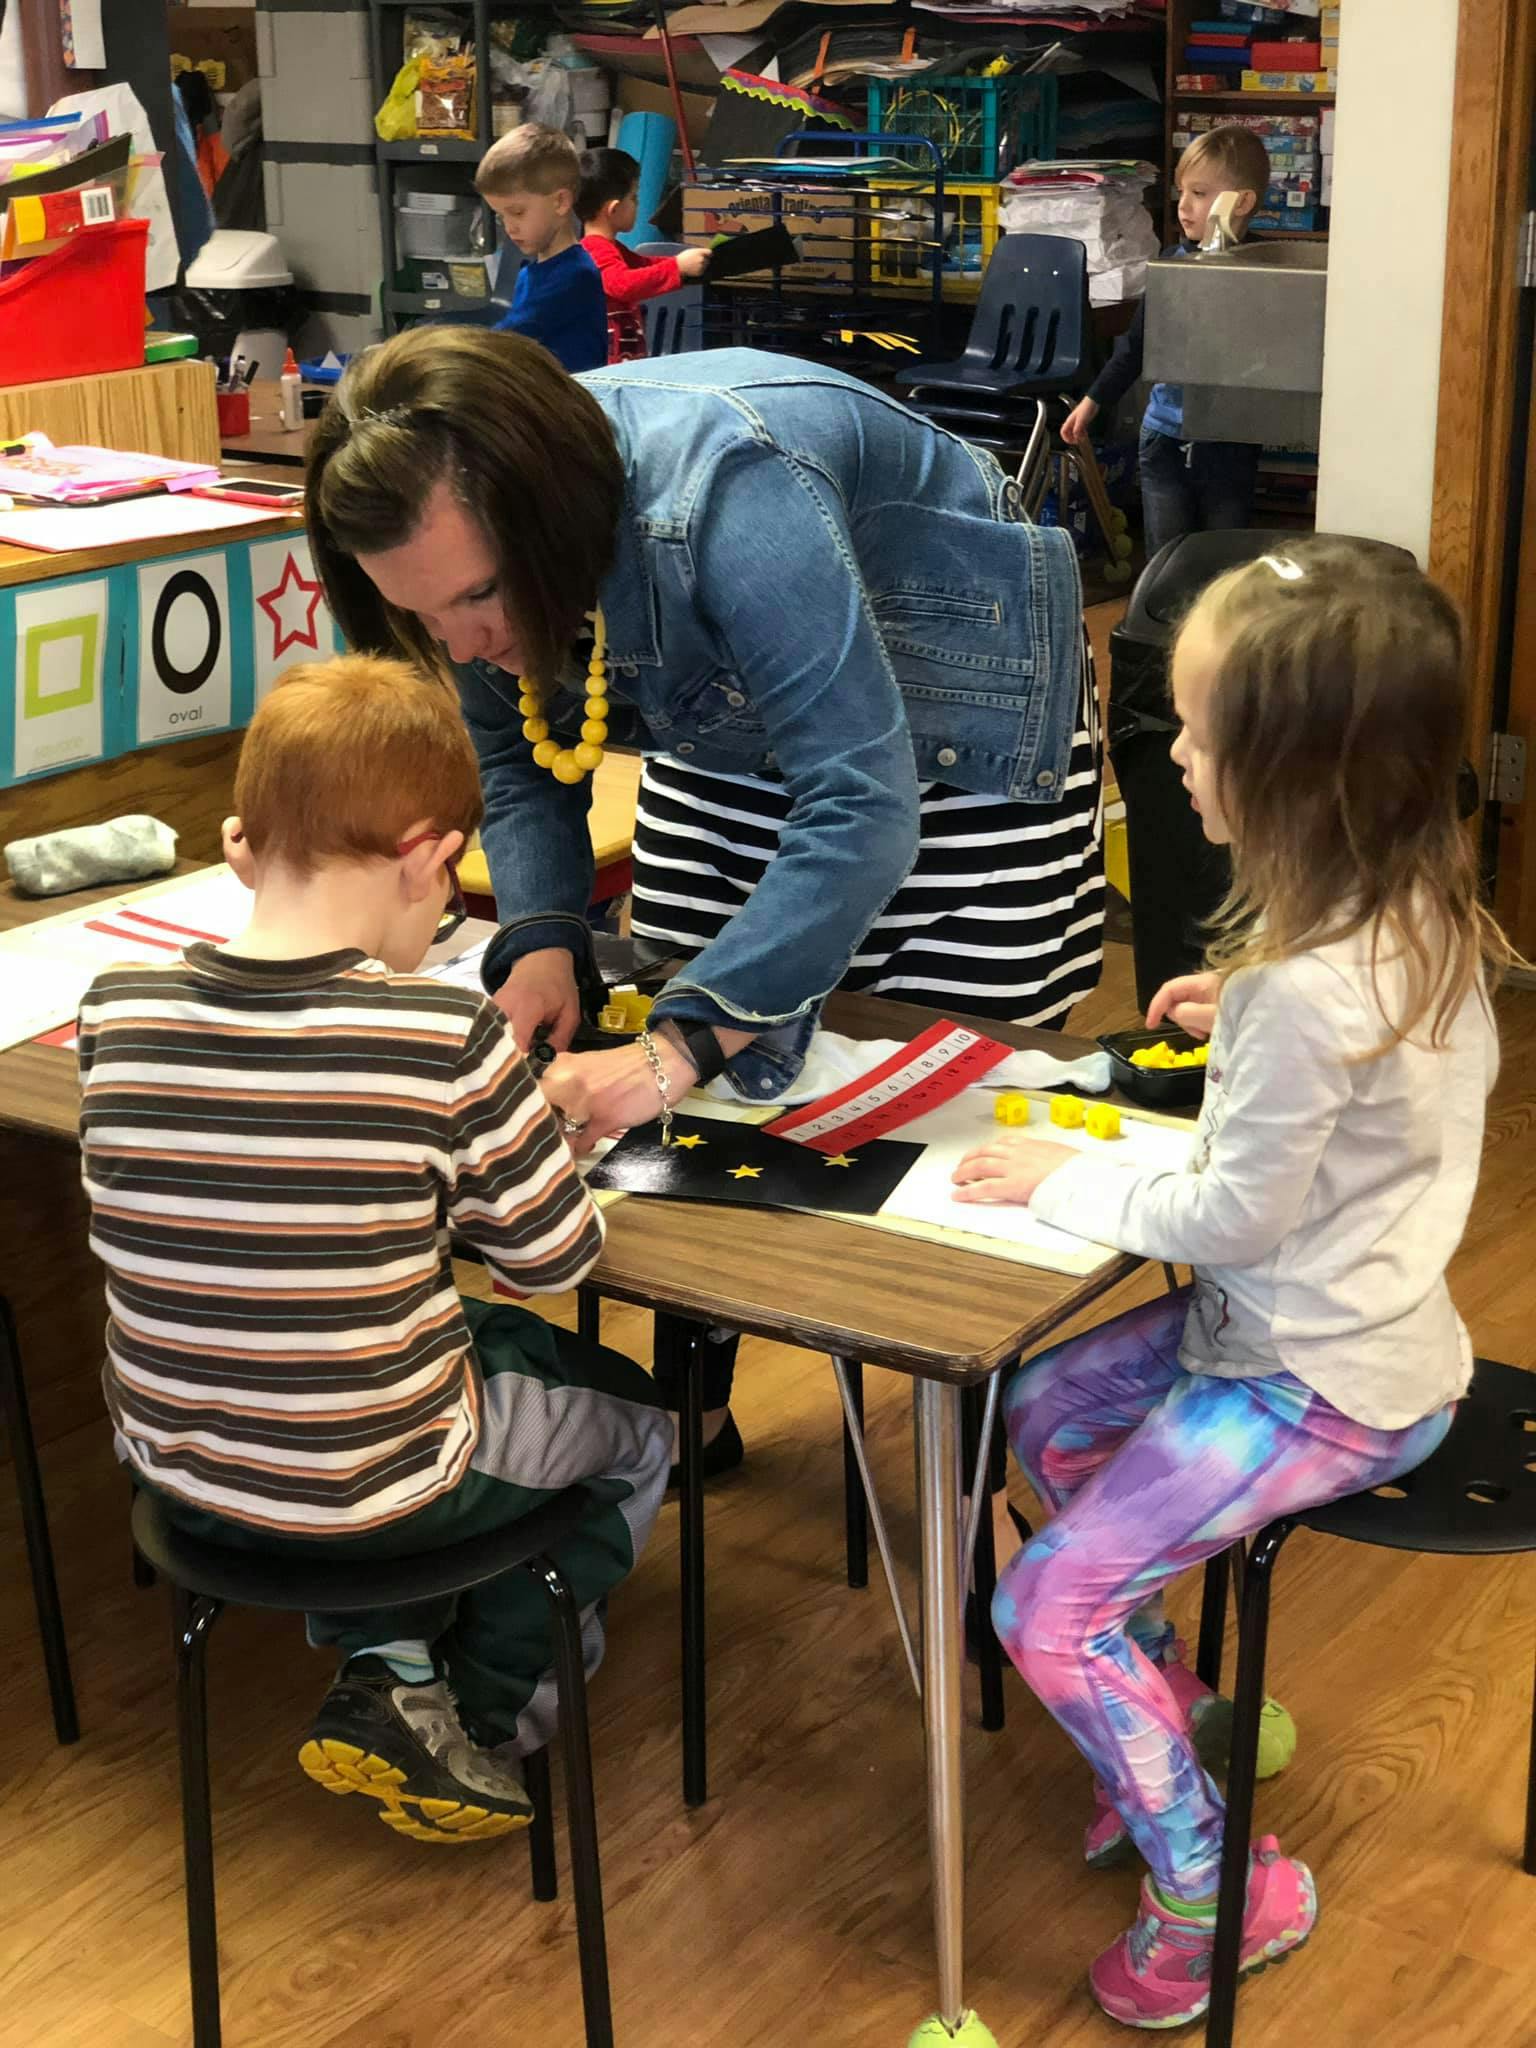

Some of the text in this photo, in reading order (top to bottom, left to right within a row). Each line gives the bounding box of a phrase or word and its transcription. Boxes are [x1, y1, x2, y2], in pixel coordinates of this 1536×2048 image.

[728, 195, 772, 211] orienta
[168, 704, 203, 724] oval
[960, 1055, 977, 1065] 19
[980, 1041, 997, 1052] 20
[812, 1123, 825, 1131] 2
[831, 1114, 844, 1122] 3
[848, 1105, 863, 1113] 4
[868, 1094, 881, 1103] 5
[887, 1083, 900, 1092] 6
[903, 1071, 915, 1081] 7
[921, 1060, 934, 1069] 8
[938, 1047, 951, 1057] 9
[954, 1032, 971, 1045] 10
